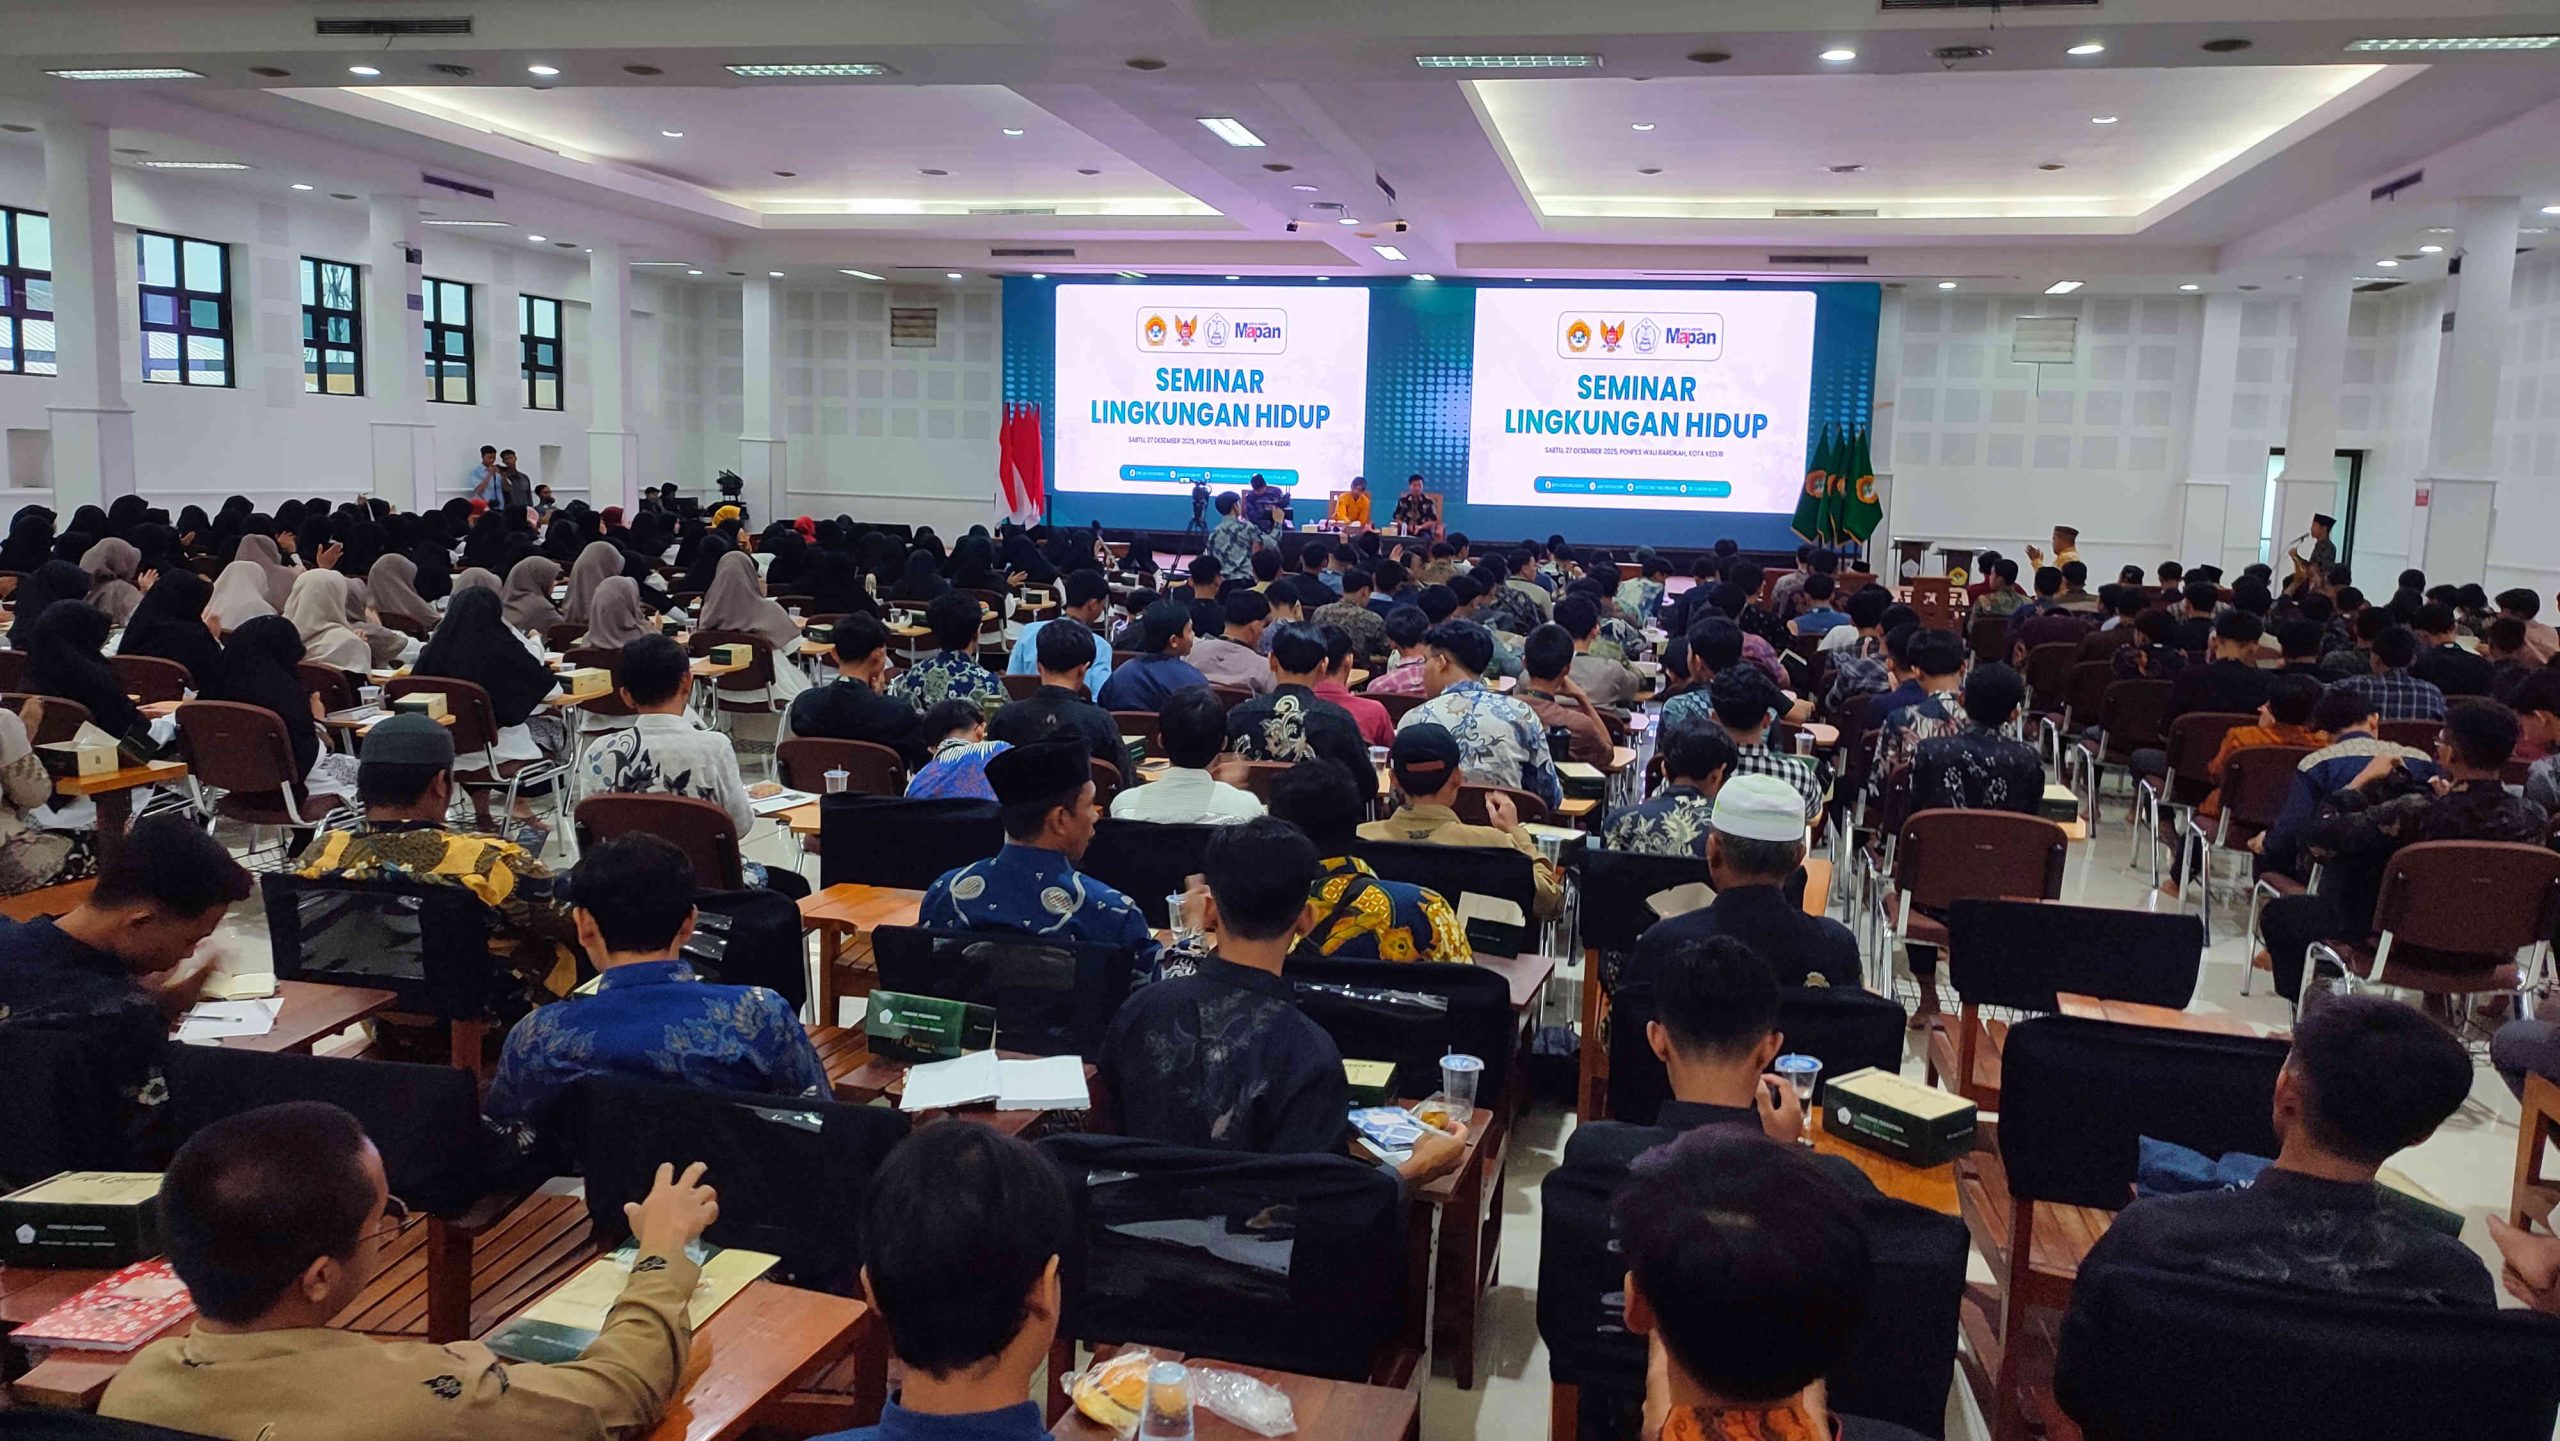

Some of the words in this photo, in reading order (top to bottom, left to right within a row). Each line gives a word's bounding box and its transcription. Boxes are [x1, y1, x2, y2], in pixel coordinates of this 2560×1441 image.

[1235, 322, 1281, 342] Mapan
[1666, 328, 1716, 348] Mapan
[1156, 367, 1264, 393] SEMINAR
[1577, 374, 1696, 402] SEMINAR
[1091, 400, 1249, 427] LINGKUNGAN
[1255, 404, 1331, 429] HIDUP
[1505, 408, 1679, 437] LINGKUNGAN
[1685, 412, 1768, 439] HIDUP
[1147, 436, 1153, 444] 27
[1196, 438, 1217, 446] PONPES
[1573, 447, 1602, 455] DESEMBER
[1603, 448, 1618, 456] 2025,
[1619, 448, 1642, 456] PONPES
